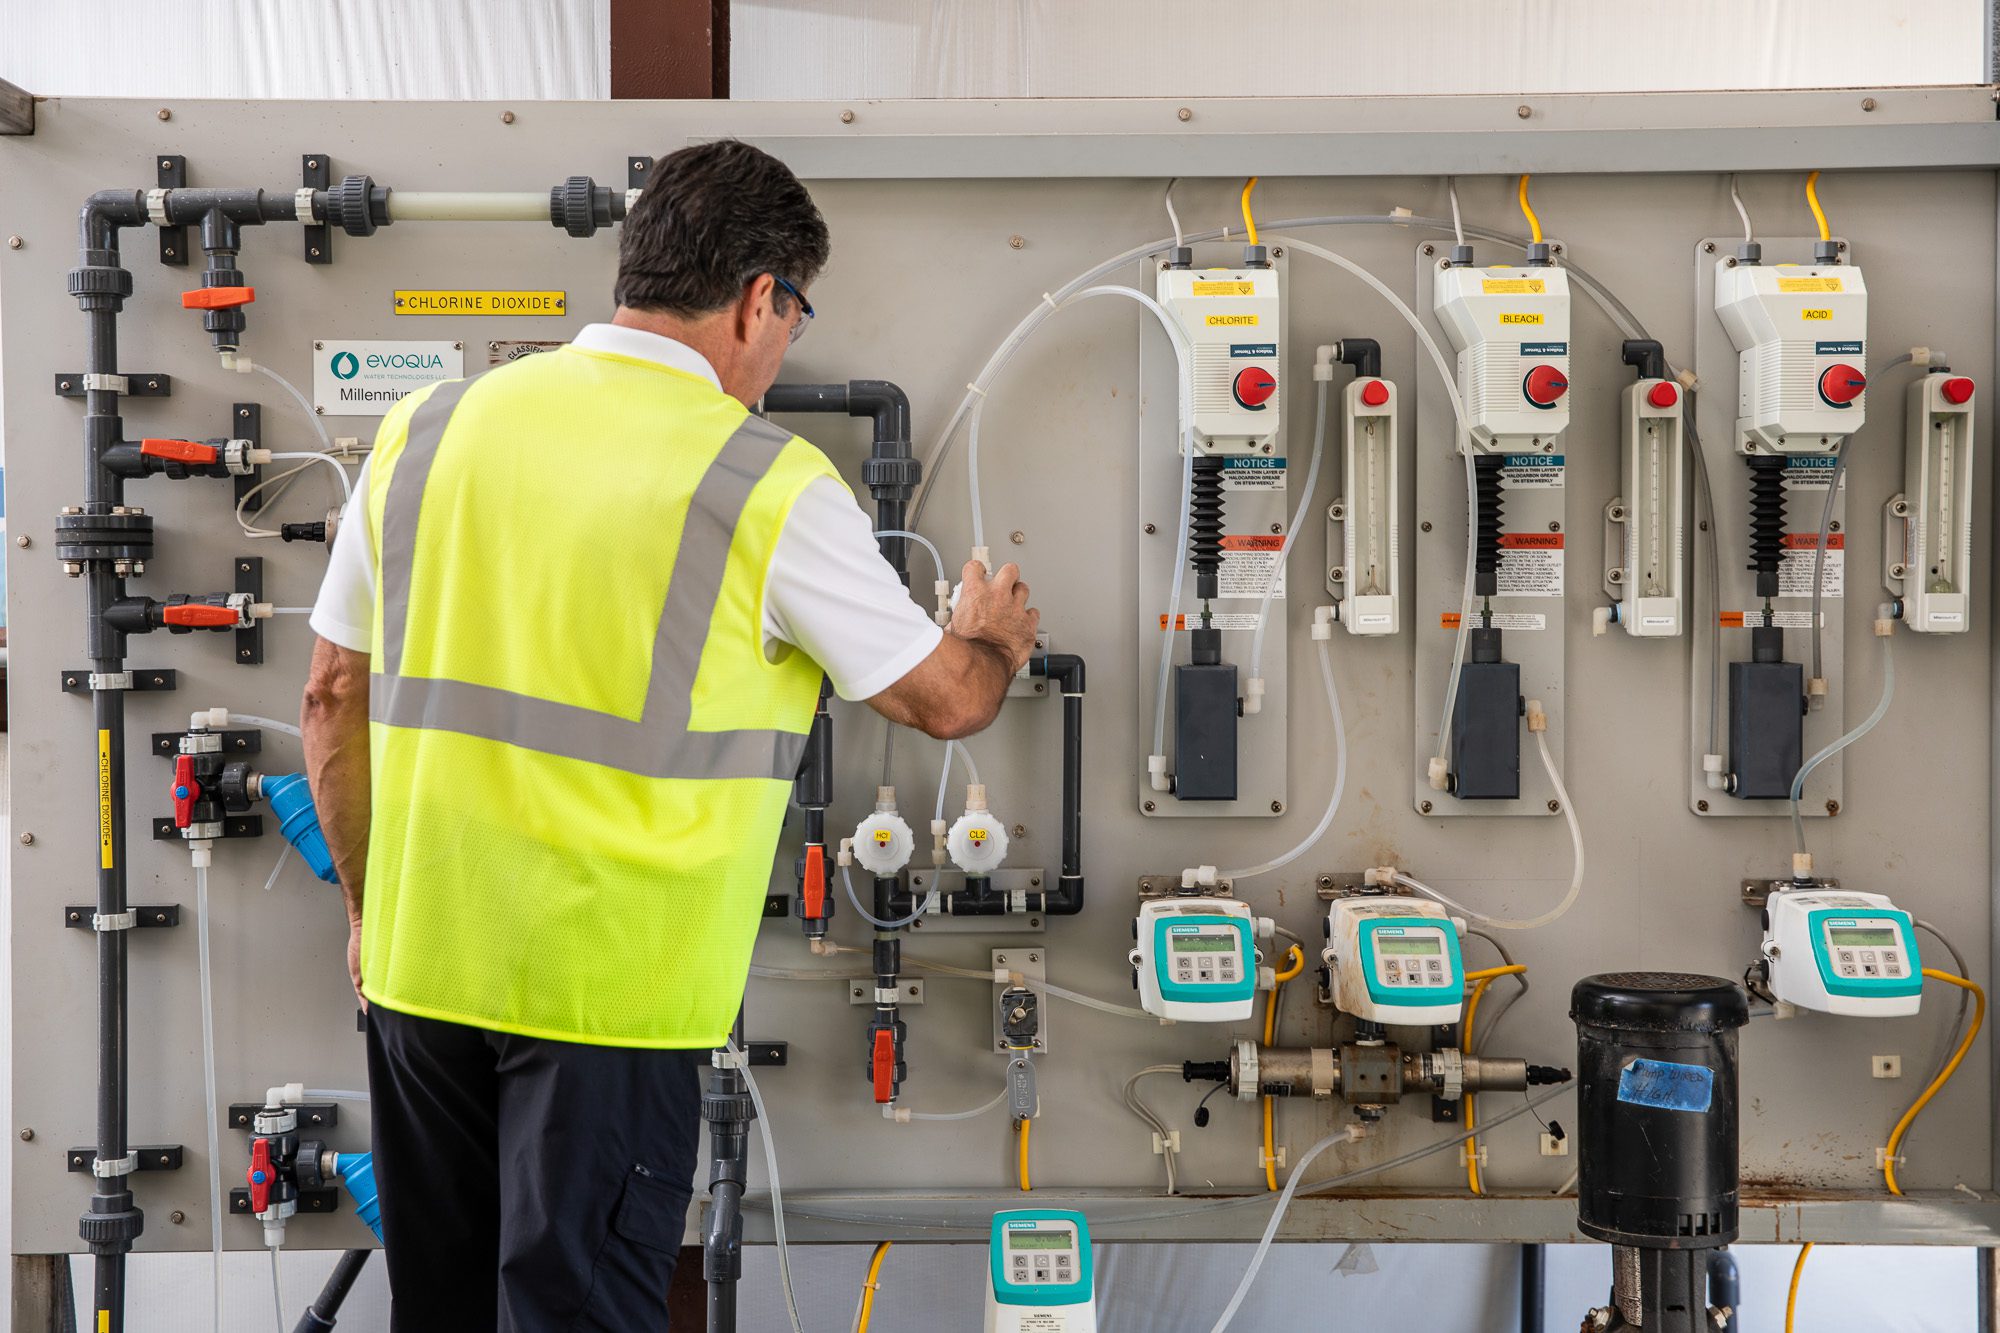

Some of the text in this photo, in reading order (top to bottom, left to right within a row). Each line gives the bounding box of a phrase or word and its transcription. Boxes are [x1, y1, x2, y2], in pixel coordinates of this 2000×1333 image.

[409, 297, 551, 309] CHLORINE DIOXIDE
[1209, 316, 1254, 325] CHLORITE
[1503, 315, 1539, 323] BLEACH
[1234, 458, 1276, 468] NOTICE
[1512, 456, 1554, 466] NOTICE
[1792, 458, 1834, 467] NOTICE
[101, 759, 110, 840] CHLORINE DIOXIDE
[970, 830, 985, 839] CL2
